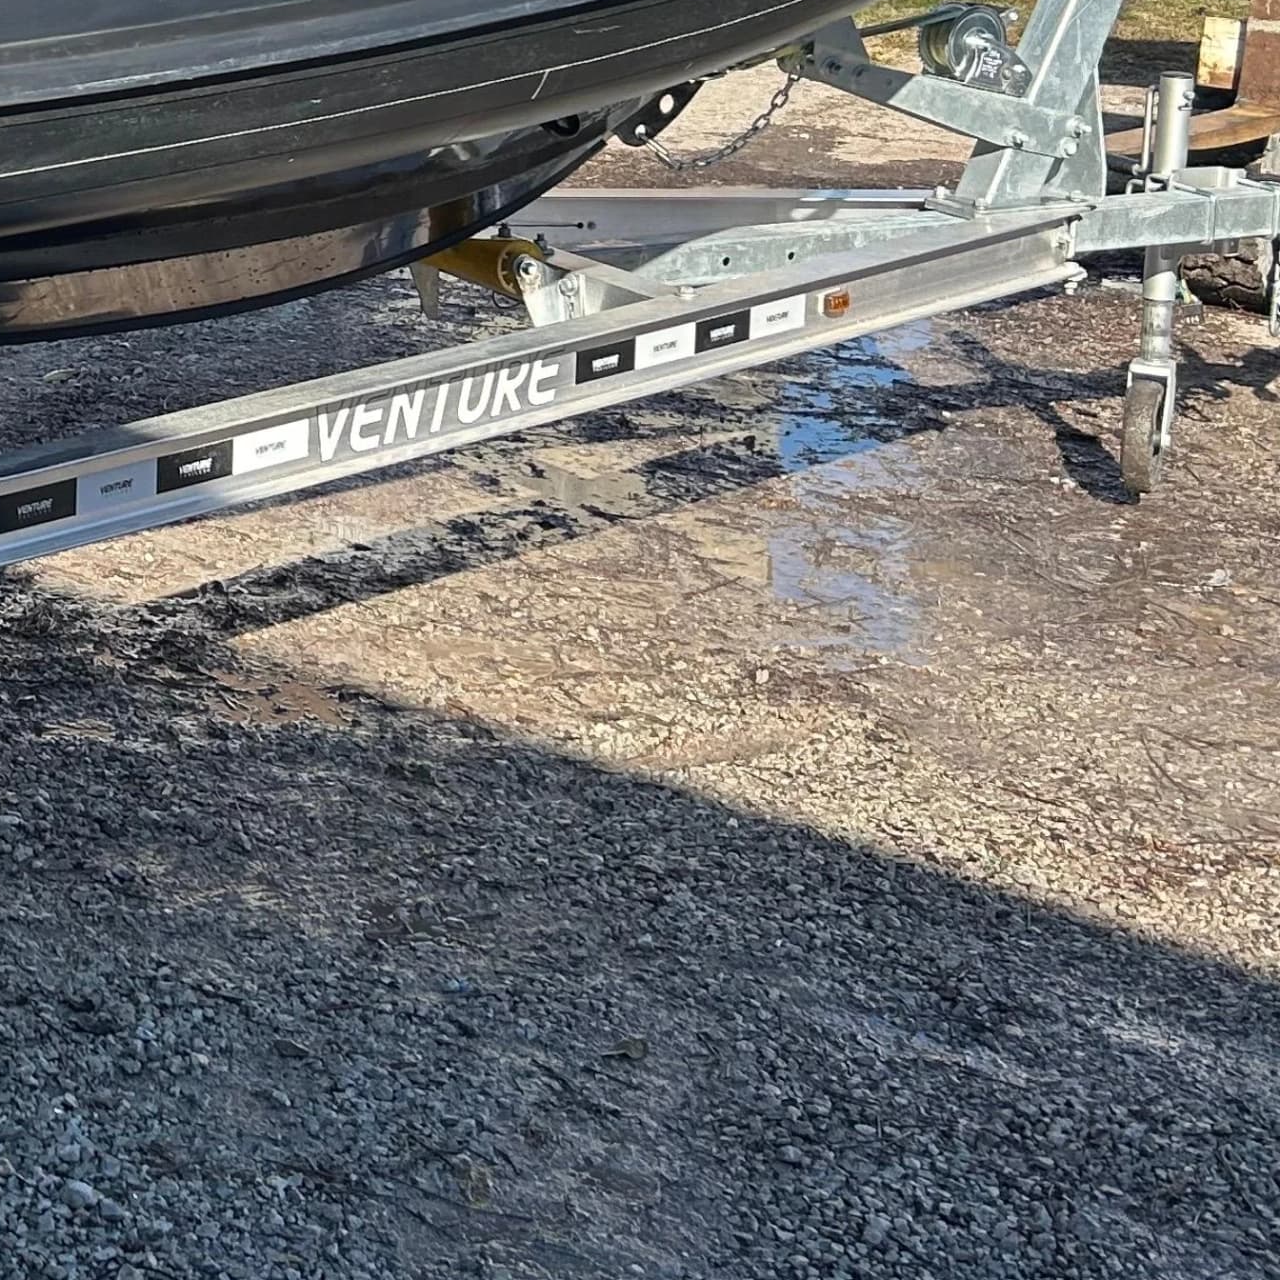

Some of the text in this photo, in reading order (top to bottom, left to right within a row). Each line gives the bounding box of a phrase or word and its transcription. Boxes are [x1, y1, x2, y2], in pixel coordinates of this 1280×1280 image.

[318, 360, 559, 462] VENTURE
[256, 440, 287, 456] VENTURE
[100, 478, 134, 495] VENTURE
[17, 498, 54, 516] VENTURE
